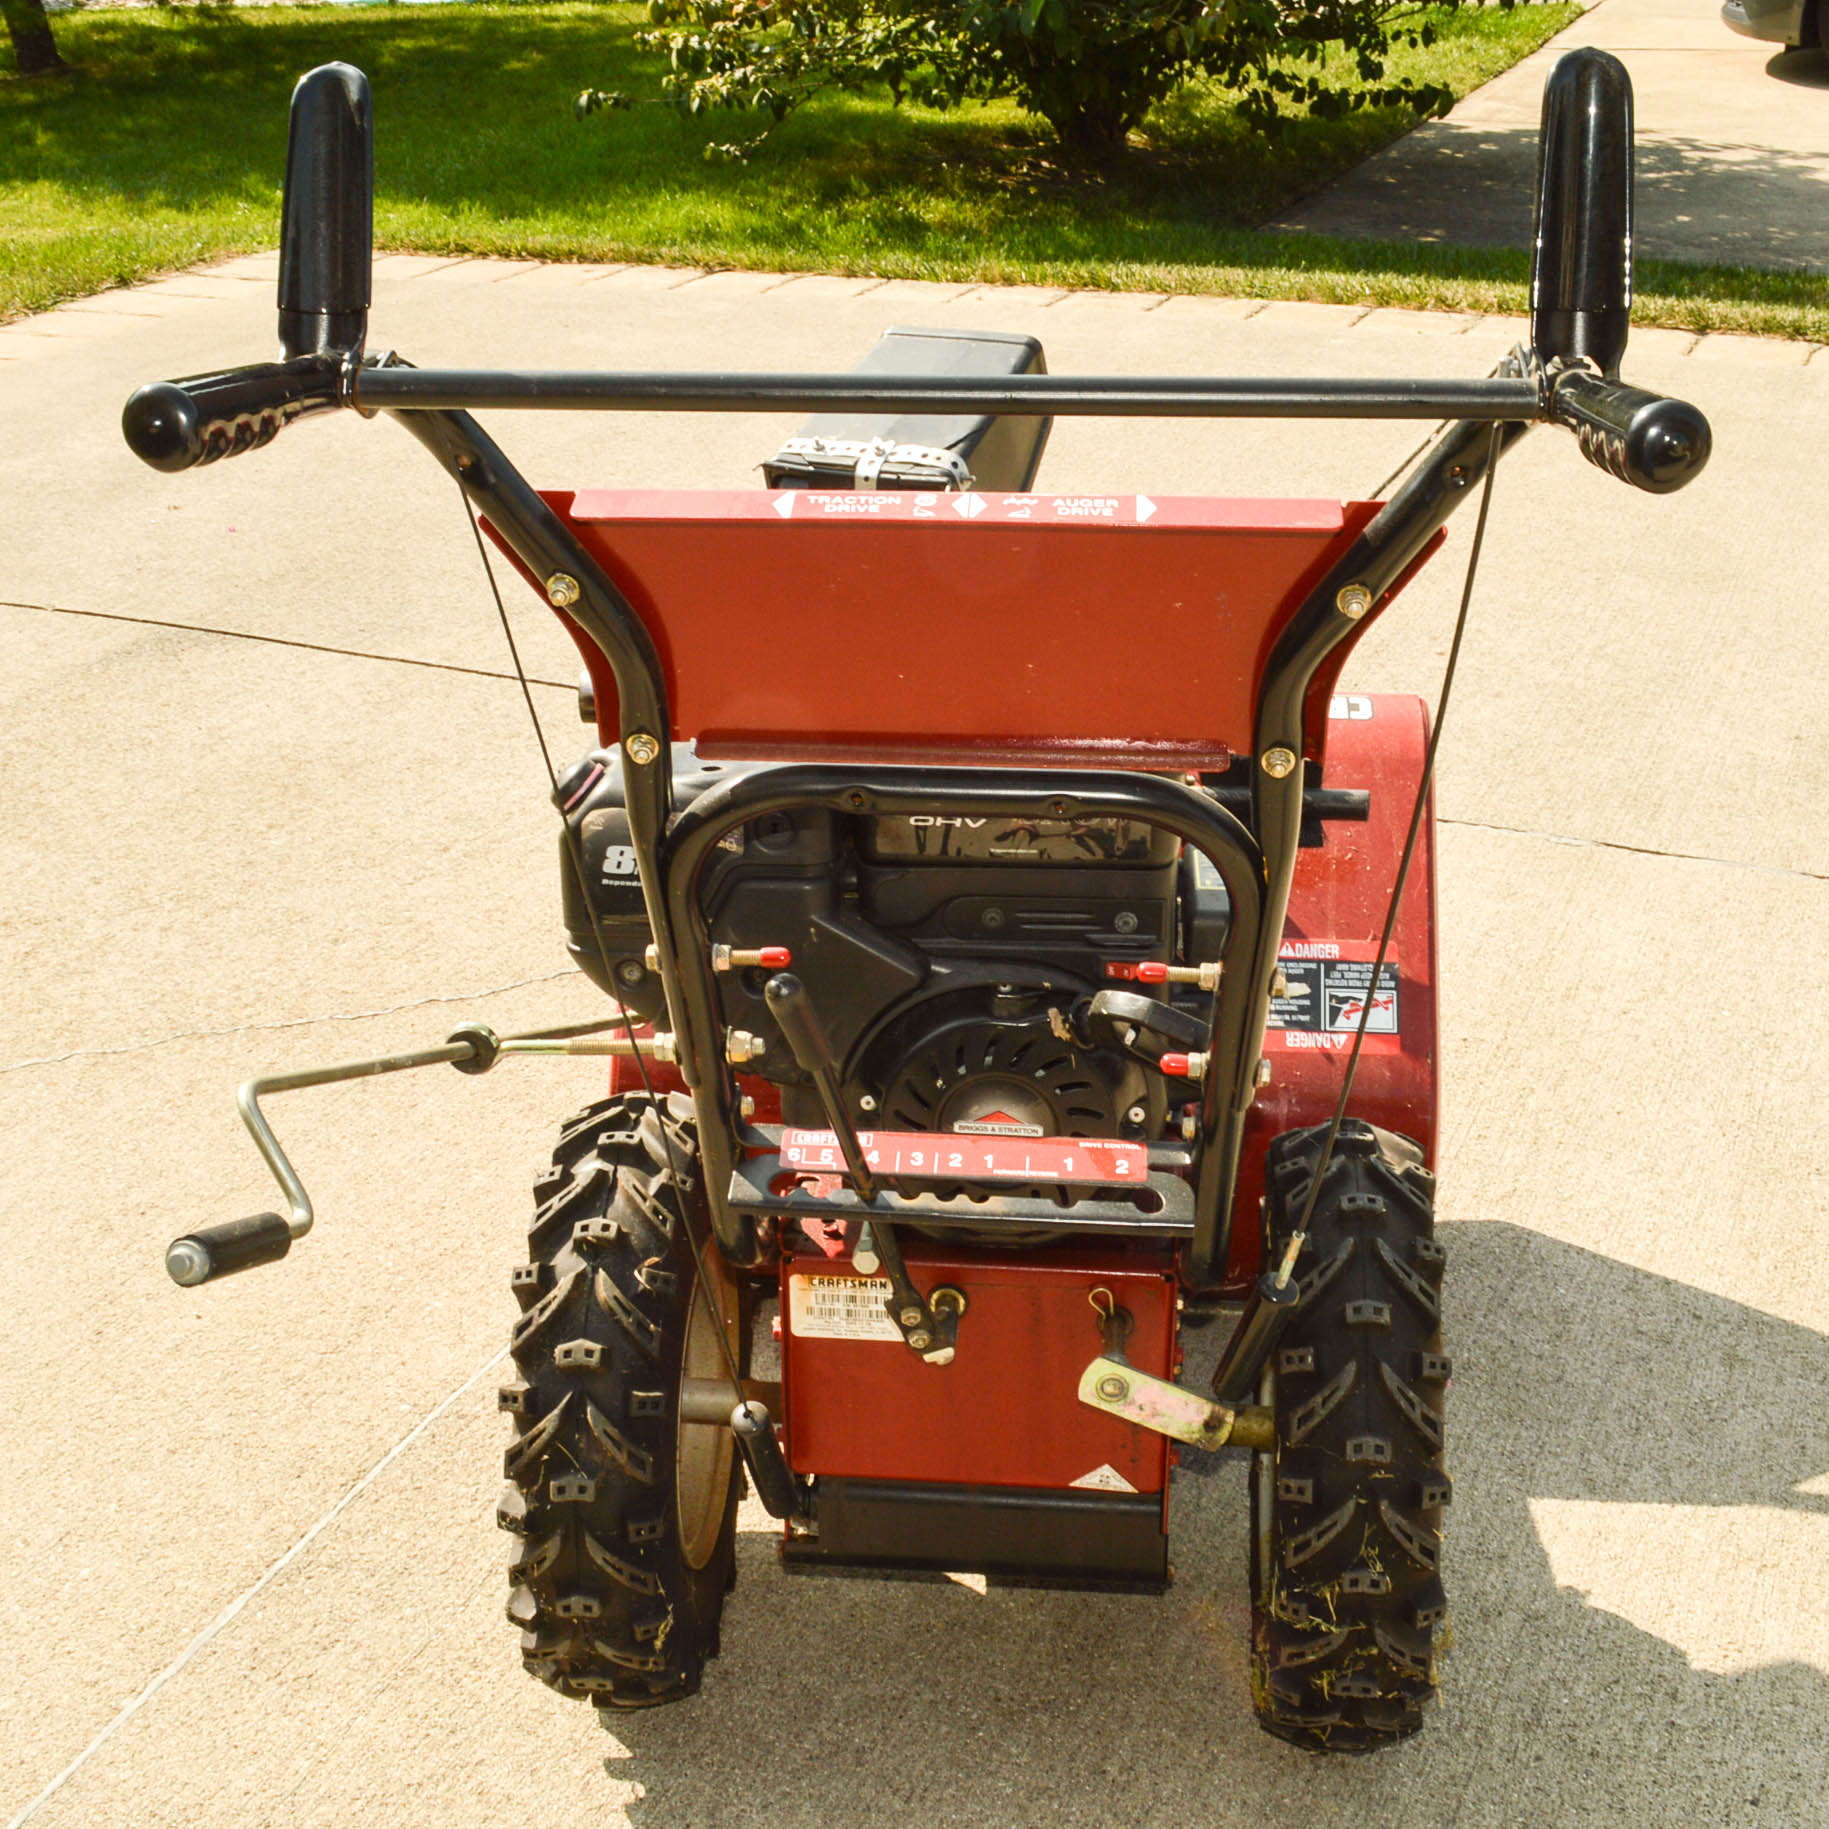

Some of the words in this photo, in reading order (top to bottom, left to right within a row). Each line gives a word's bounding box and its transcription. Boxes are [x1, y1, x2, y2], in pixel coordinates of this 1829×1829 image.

[807, 495, 902, 505] TRACTION
[1052, 498, 1119, 508] AUGER
[824, 503, 880, 513] DRIVE
[1057, 507, 1113, 517] DRIVE
[909, 816, 987, 828] OHV
[602, 845, 639, 875] 8
[1295, 943, 1340, 959] DANGER
[1285, 1031, 1332, 1049] DANGER
[958, 1124, 988, 1133] BRIGGS
[998, 1126, 1040, 1136] STRATTON
[796, 1133, 868, 1145] CRAFTN
[787, 1147, 801, 1162] 6
[819, 1148, 834, 1162] 5
[865, 1149, 880, 1164] 4
[910, 1151, 924, 1166] 3
[948, 1153, 963, 1168] 2
[983, 1154, 994, 1169] 1
[1063, 1157, 1073, 1172] 1
[1115, 1159, 1129, 1174] 2
[810, 1278, 888, 1289] CRAFTSMAN
